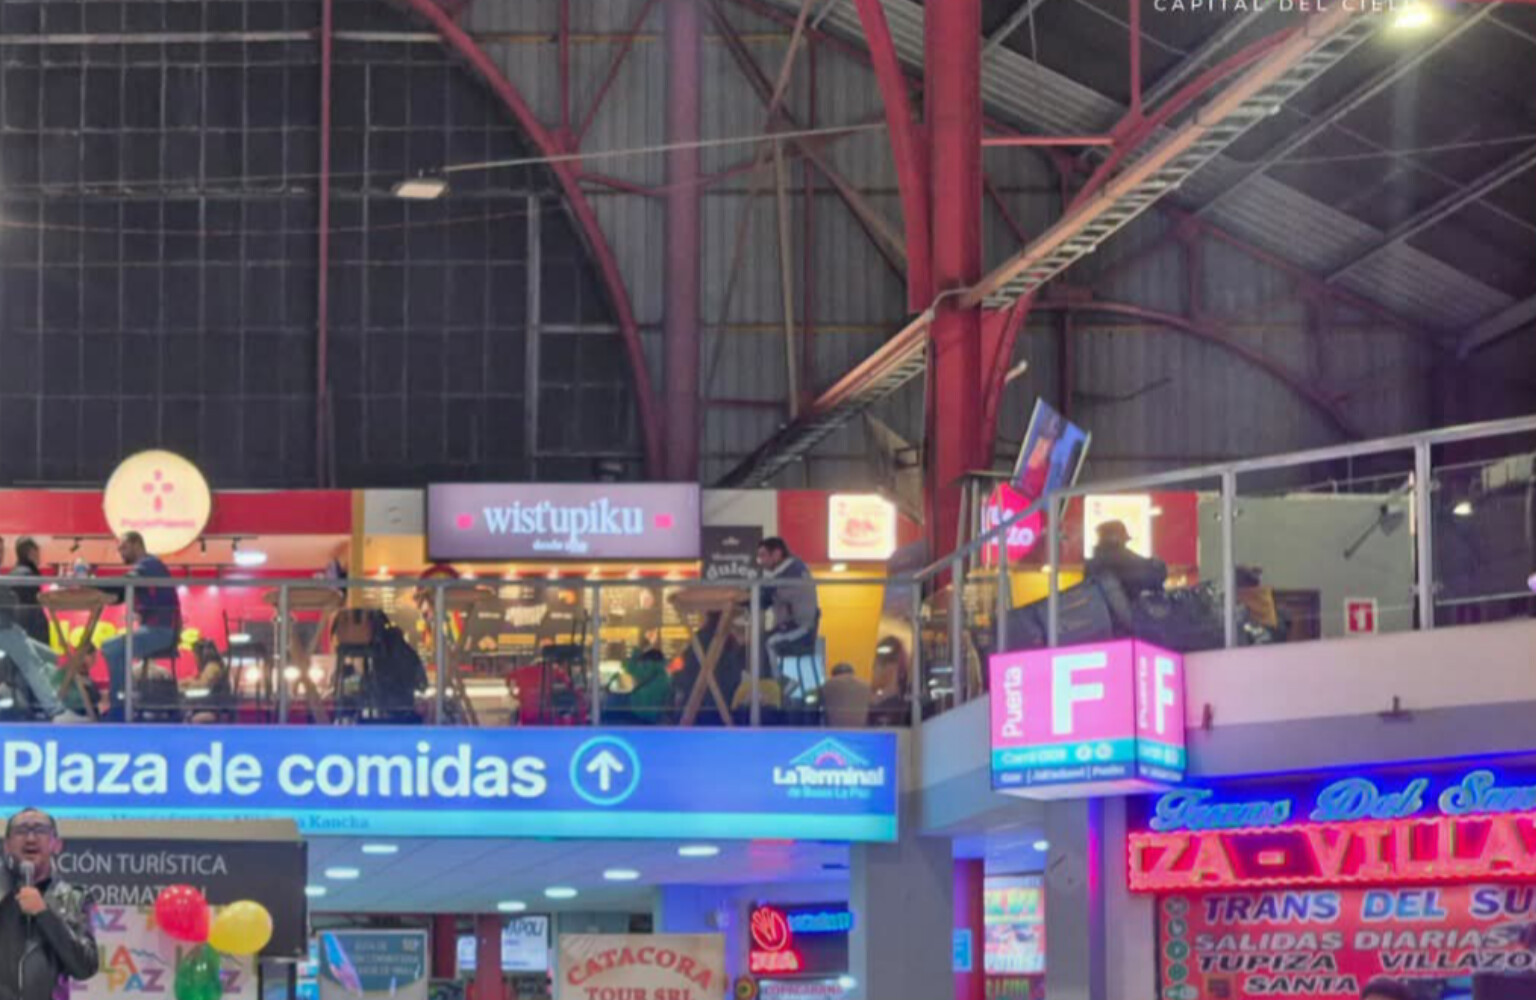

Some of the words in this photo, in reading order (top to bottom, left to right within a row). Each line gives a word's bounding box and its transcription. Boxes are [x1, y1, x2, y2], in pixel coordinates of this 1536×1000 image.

[1002, 666, 1023, 738] Puerta
[1052, 652, 1108, 735] F
[1154, 655, 1175, 735] F
[3, 741, 168, 795] Plaza
[185, 742, 262, 795] de
[278, 740, 547, 798] comidas
[119, 851, 228, 875] TURÍSTICA
[1203, 892, 1341, 924] TRANS
[1362, 890, 1447, 921] DEL
[1195, 931, 1343, 951] SALIDAS
[1354, 926, 1510, 951] DIARIAS
[98, 945, 138, 974] LA
[566, 946, 714, 990] CATACORA
[1199, 953, 1337, 973] TUPIZA
[1379, 950, 1536, 973] VILLAZO
[107, 967, 165, 993] PAZ
[1244, 974, 1359, 995] SANTA
